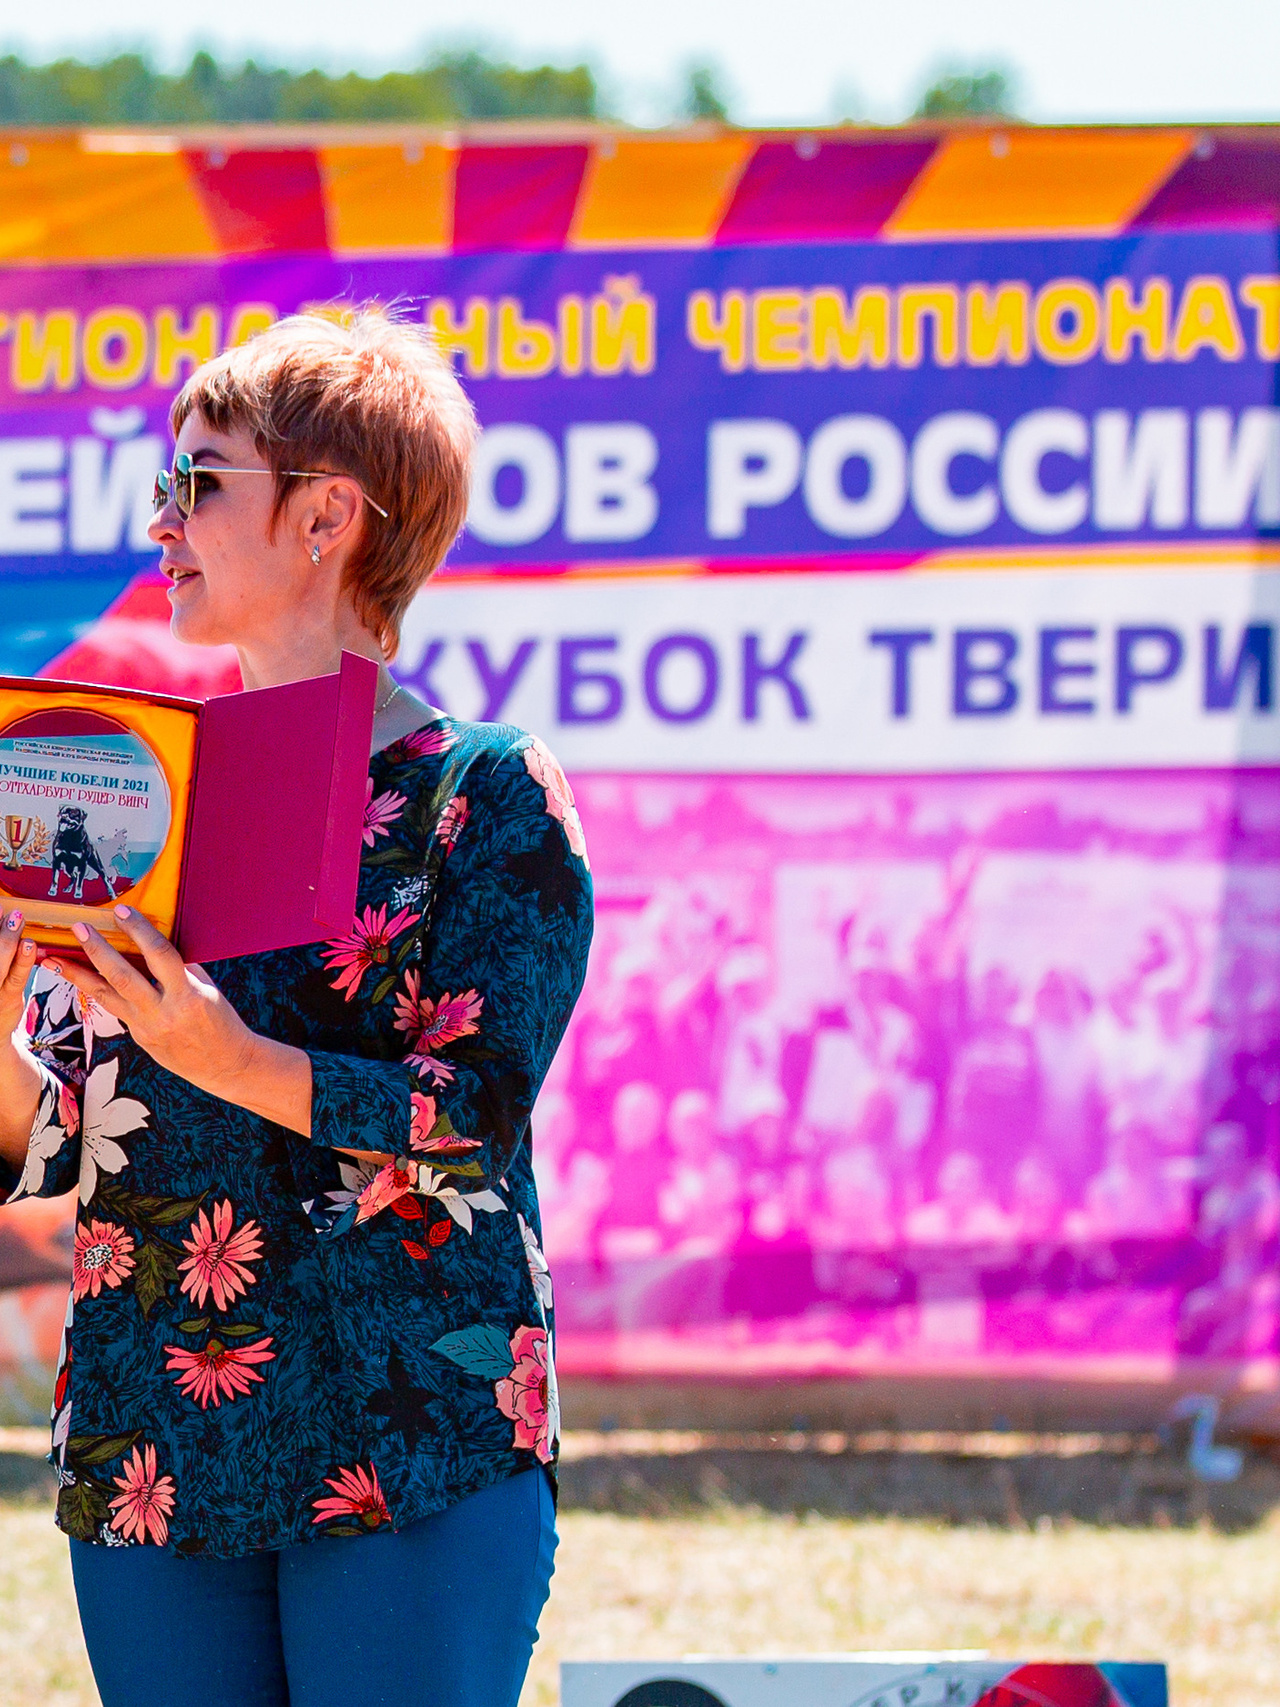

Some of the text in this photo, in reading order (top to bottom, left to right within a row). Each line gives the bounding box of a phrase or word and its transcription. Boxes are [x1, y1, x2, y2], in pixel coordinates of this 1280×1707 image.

[708, 408, 1280, 538] РОССИИ
[870, 622, 1273, 719] ТВЕРИ
[60, 771, 119, 789] КОБЕЛИ
[122, 778, 149, 792] 2021
[77, 789, 115, 805] РУДЕР
